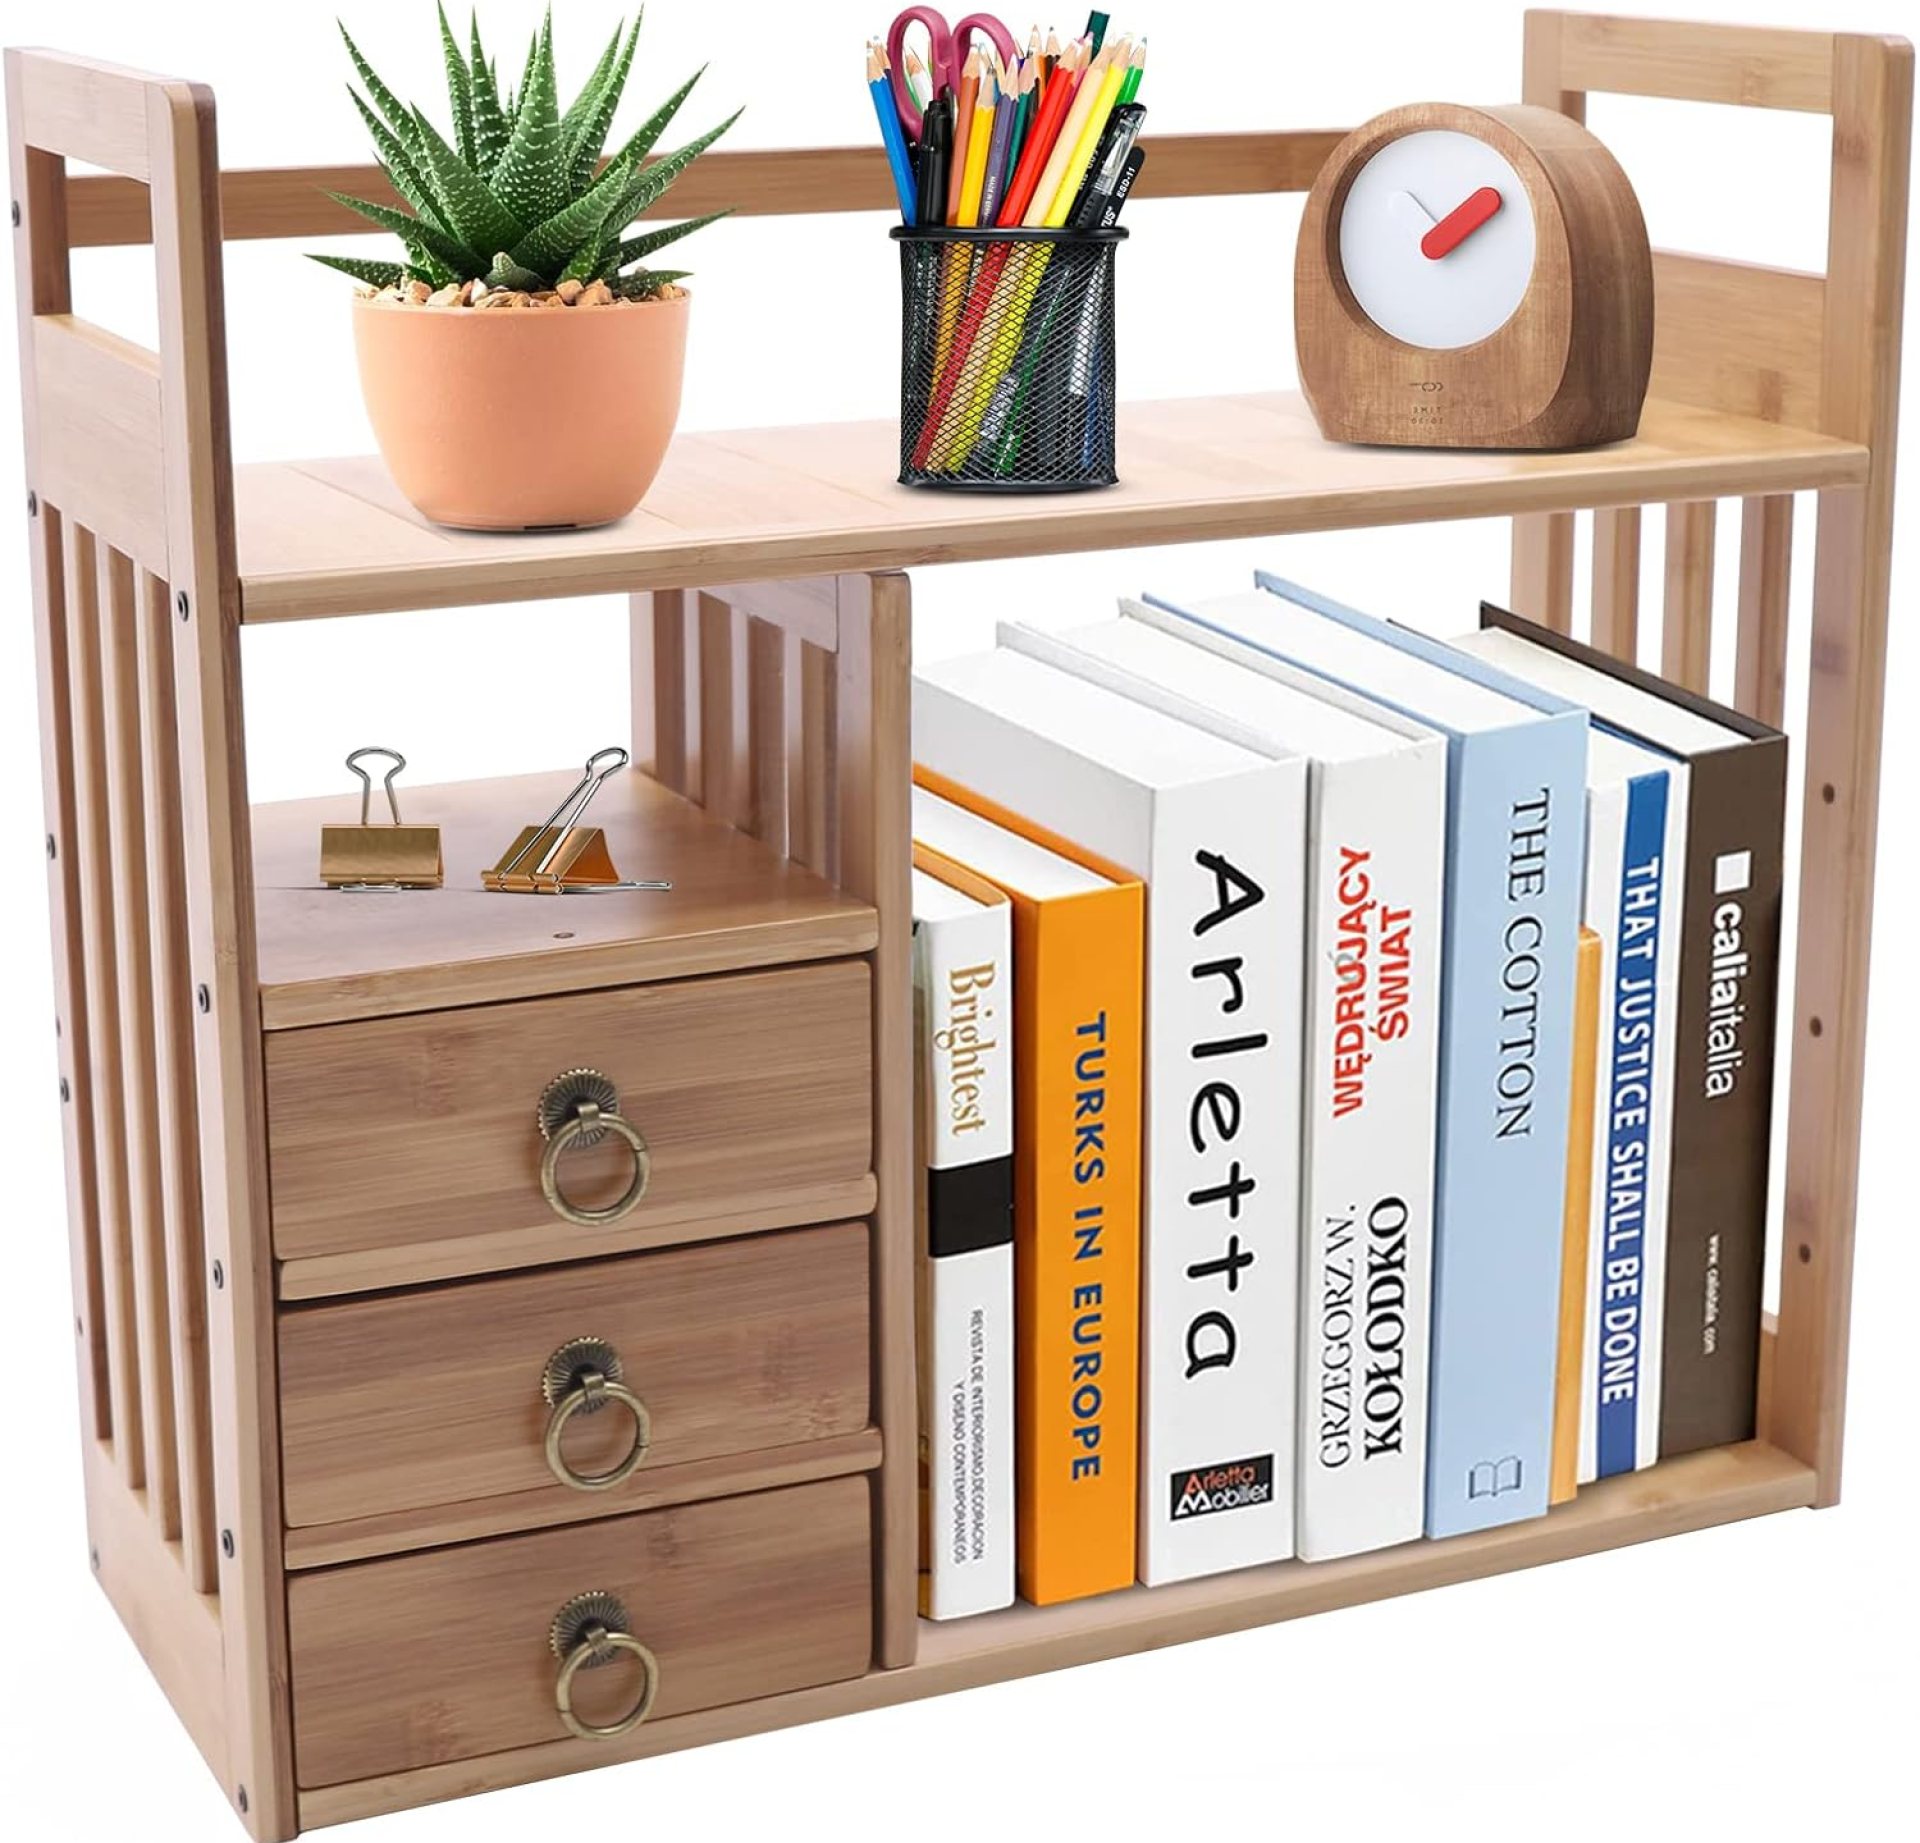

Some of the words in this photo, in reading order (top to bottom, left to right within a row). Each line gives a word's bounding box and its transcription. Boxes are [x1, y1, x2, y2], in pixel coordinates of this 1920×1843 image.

[1508, 787, 1549, 901] THE
[1623, 857, 1659, 959] THAT
[1333, 847, 1376, 1117] WĘDRUJĄCY
[1369, 906, 1411, 1041] ŚWIAT
[1496, 915, 1542, 1139] COTTON
[1706, 902, 1747, 1099] caliaitalia
[934, 961, 996, 1137] Brightest
[1074, 1011, 1106, 1184] TURKS
[1186, 849, 1267, 1379] Arletta
[1614, 976, 1656, 1130] JUSTICE
[1074, 1206, 1104, 1261] IN
[1326, 1205, 1357, 1254] W.
[1608, 1142, 1645, 1251] SHALL
[971, 1309, 984, 1364] REVISTA
[1364, 1197, 1408, 1460] KOŁODKO
[1606, 1260, 1640, 1301] BE
[1072, 1283, 1102, 1481] EUROPE
[1320, 1258, 1354, 1468] GRZEGORZ
[1602, 1307, 1638, 1404] DONE
[1185, 1466, 1256, 1494] Arletta
